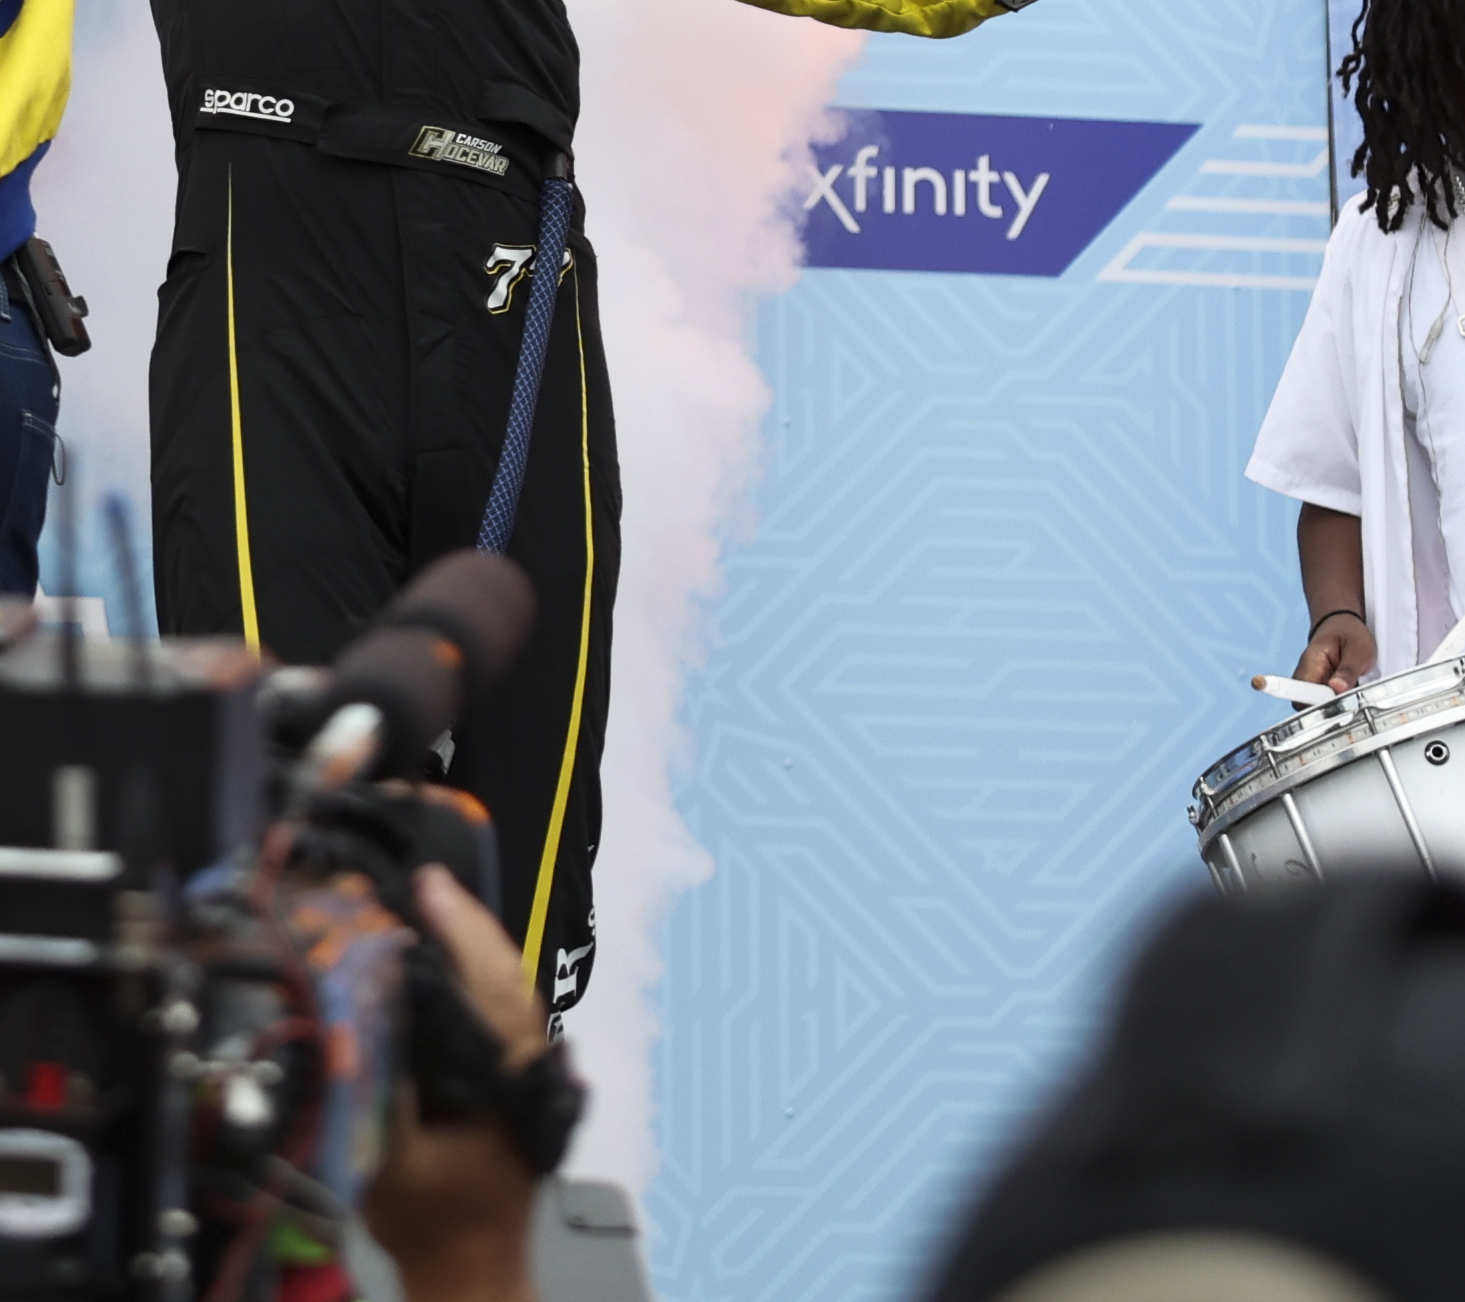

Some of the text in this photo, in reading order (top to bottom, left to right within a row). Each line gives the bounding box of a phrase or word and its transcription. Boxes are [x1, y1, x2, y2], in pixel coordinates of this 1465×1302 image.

[200, 88, 295, 122] sparco
[454, 132, 503, 154] CARSON
[802, 144, 1050, 241] xfinity
[483, 241, 574, 315] 7
